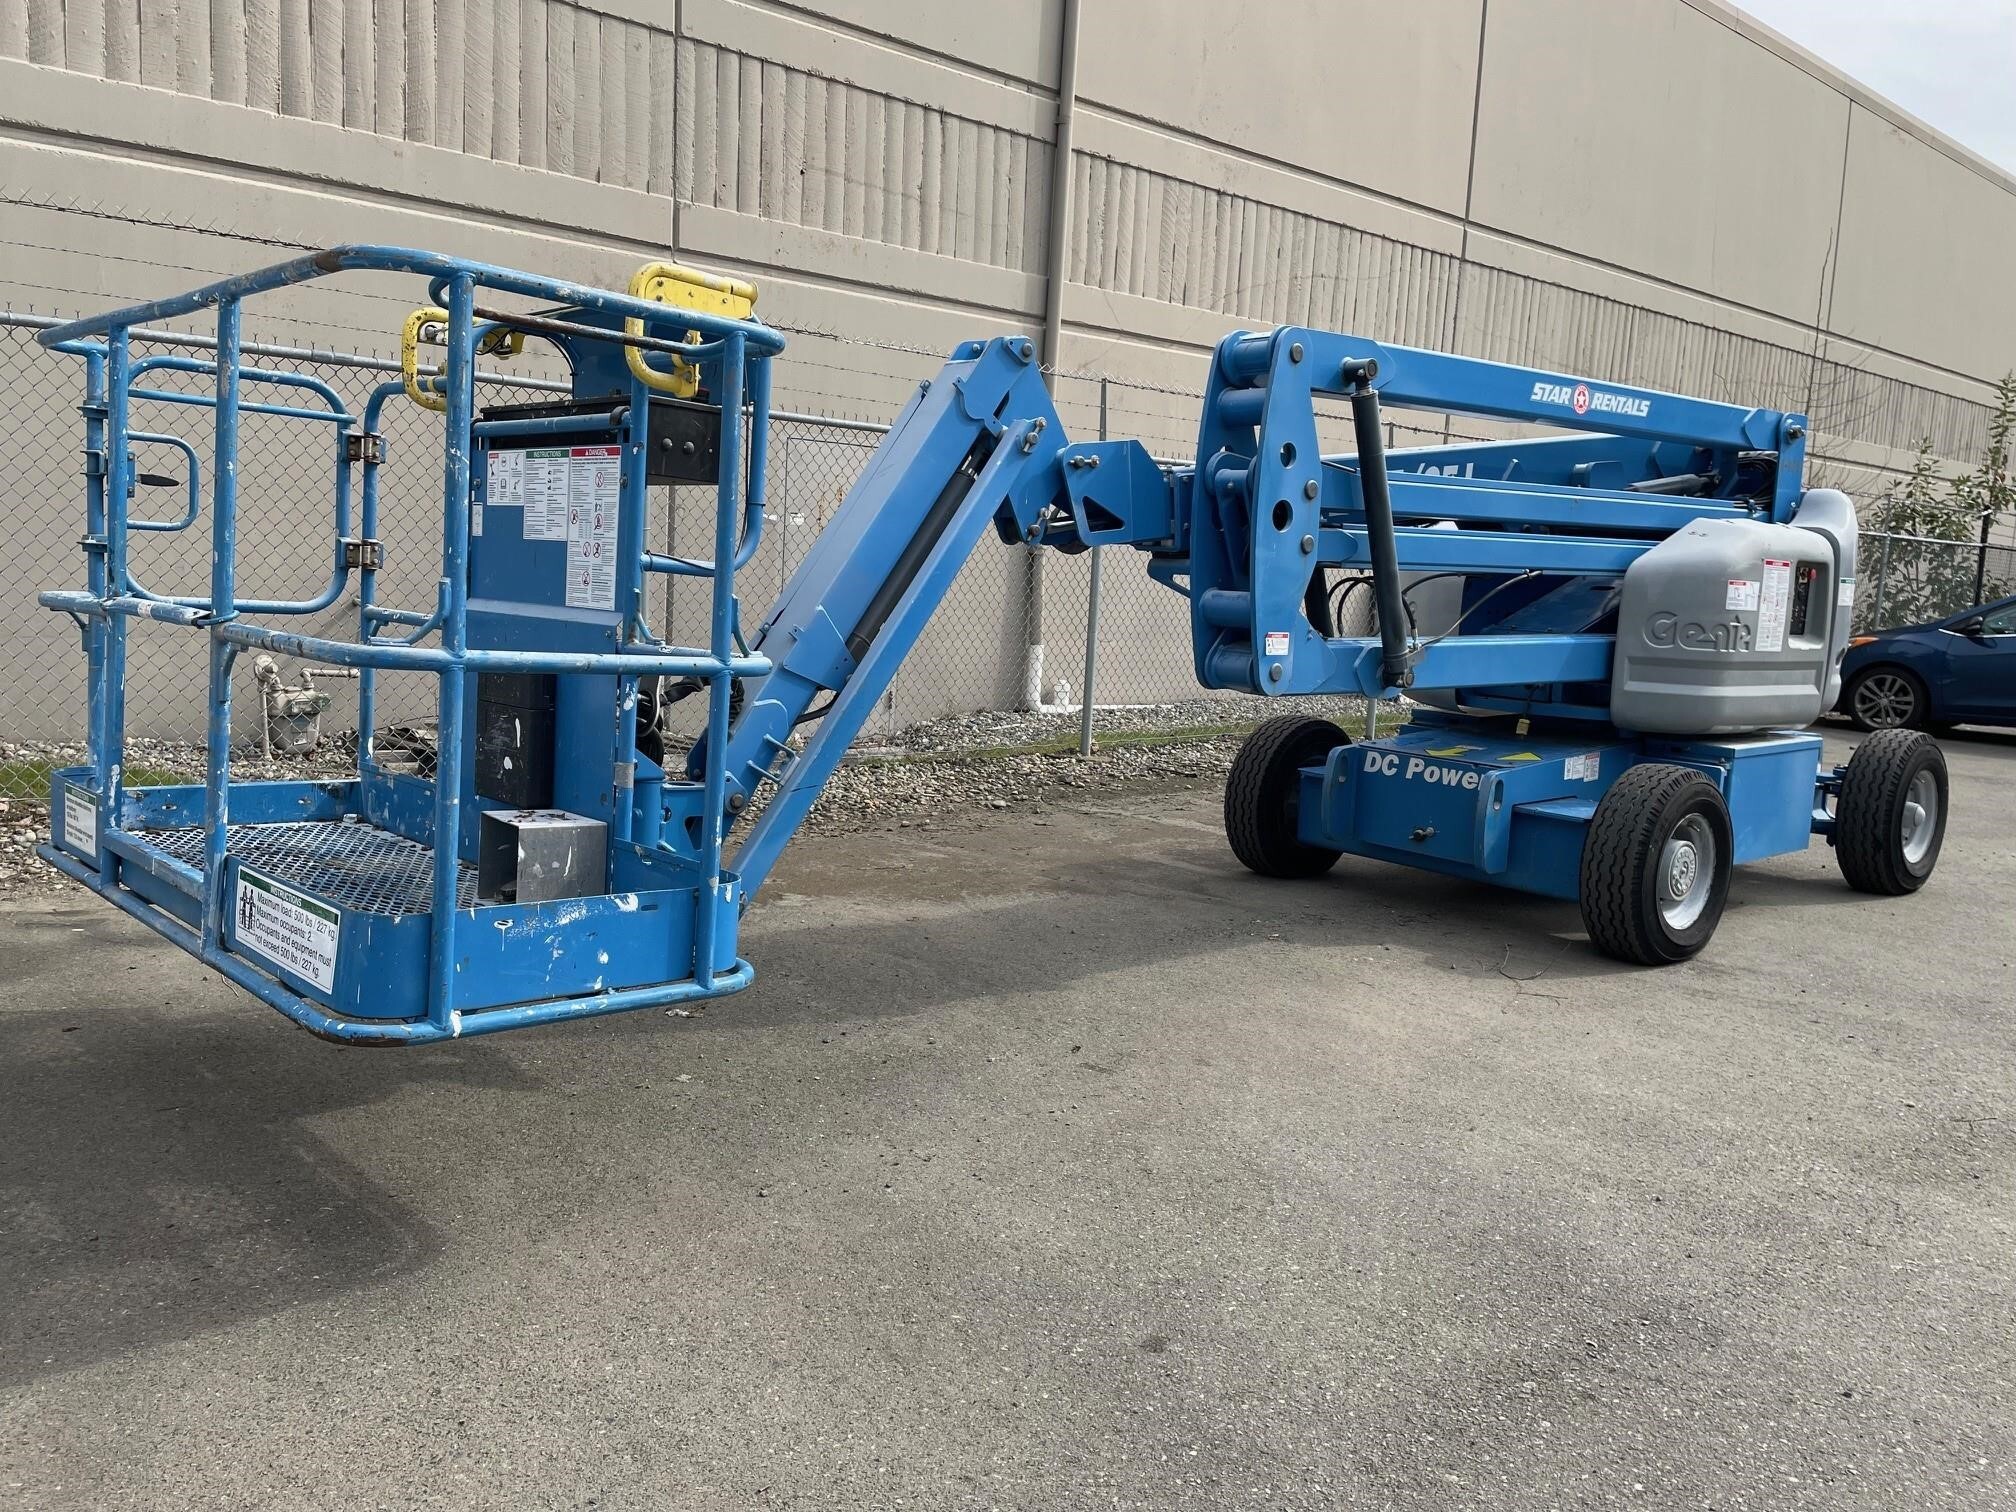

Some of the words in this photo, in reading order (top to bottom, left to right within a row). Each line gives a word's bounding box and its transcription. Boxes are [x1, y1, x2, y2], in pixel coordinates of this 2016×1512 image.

[1531, 382, 1572, 404] STAR
[1591, 392, 1651, 417] RENTALS
[533, 450, 562, 458] INSTRUCTIONS
[1643, 610, 1752, 653] Genie
[1363, 750, 1400, 776] DC
[256, 905, 280, 926] Maximum
[257, 891, 280, 912] Maximum
[294, 910, 304, 924] 500
[305, 914, 313, 928] lbs
[317, 921, 327, 935] 227
[256, 918, 280, 940] Occupants
[281, 934, 291, 946] and
[291, 939, 318, 960] equipment
[318, 953, 332, 968] must
[263, 938, 279, 955] exceed
[281, 946, 290, 960] 500
[302, 958, 312, 972] 227
